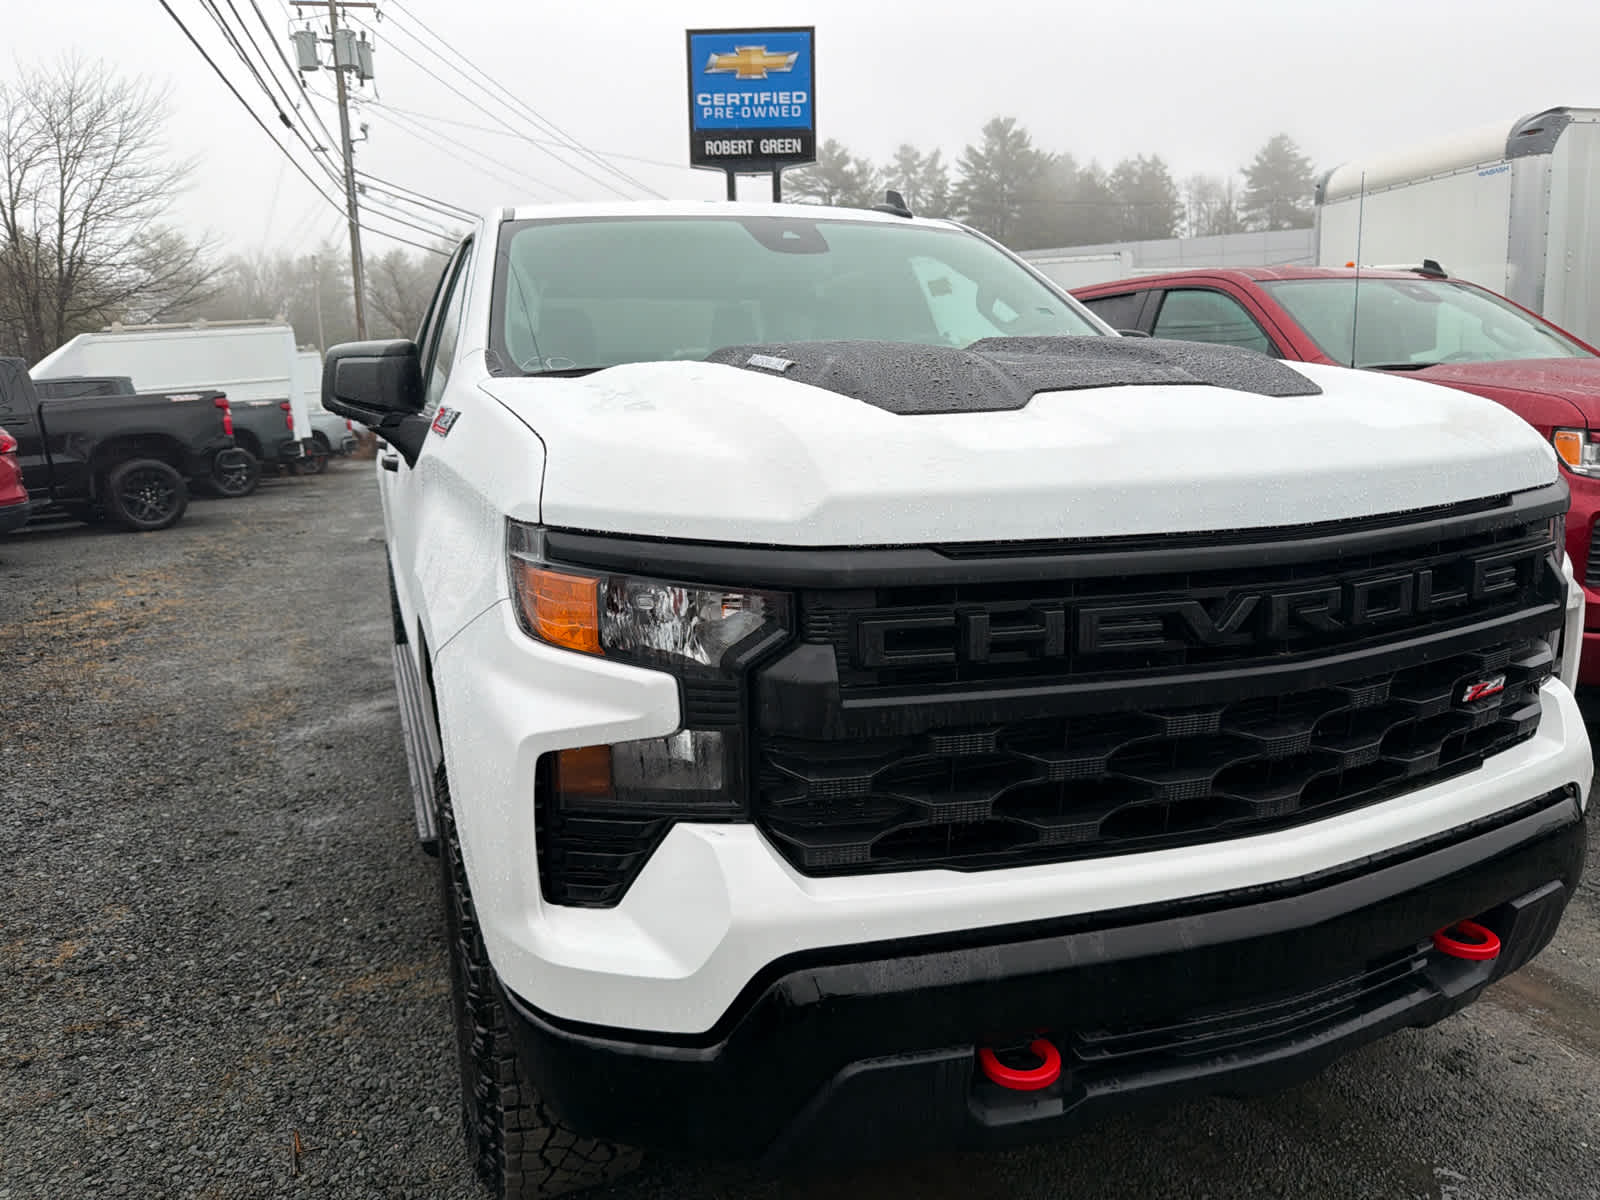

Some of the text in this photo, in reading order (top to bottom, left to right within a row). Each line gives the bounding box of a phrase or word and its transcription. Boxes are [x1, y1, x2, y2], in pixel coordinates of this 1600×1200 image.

[697, 91, 807, 106] CERTIFIED
[703, 105, 801, 119] PRE-OWNED
[705, 138, 802, 155] ROBERT GREEN
